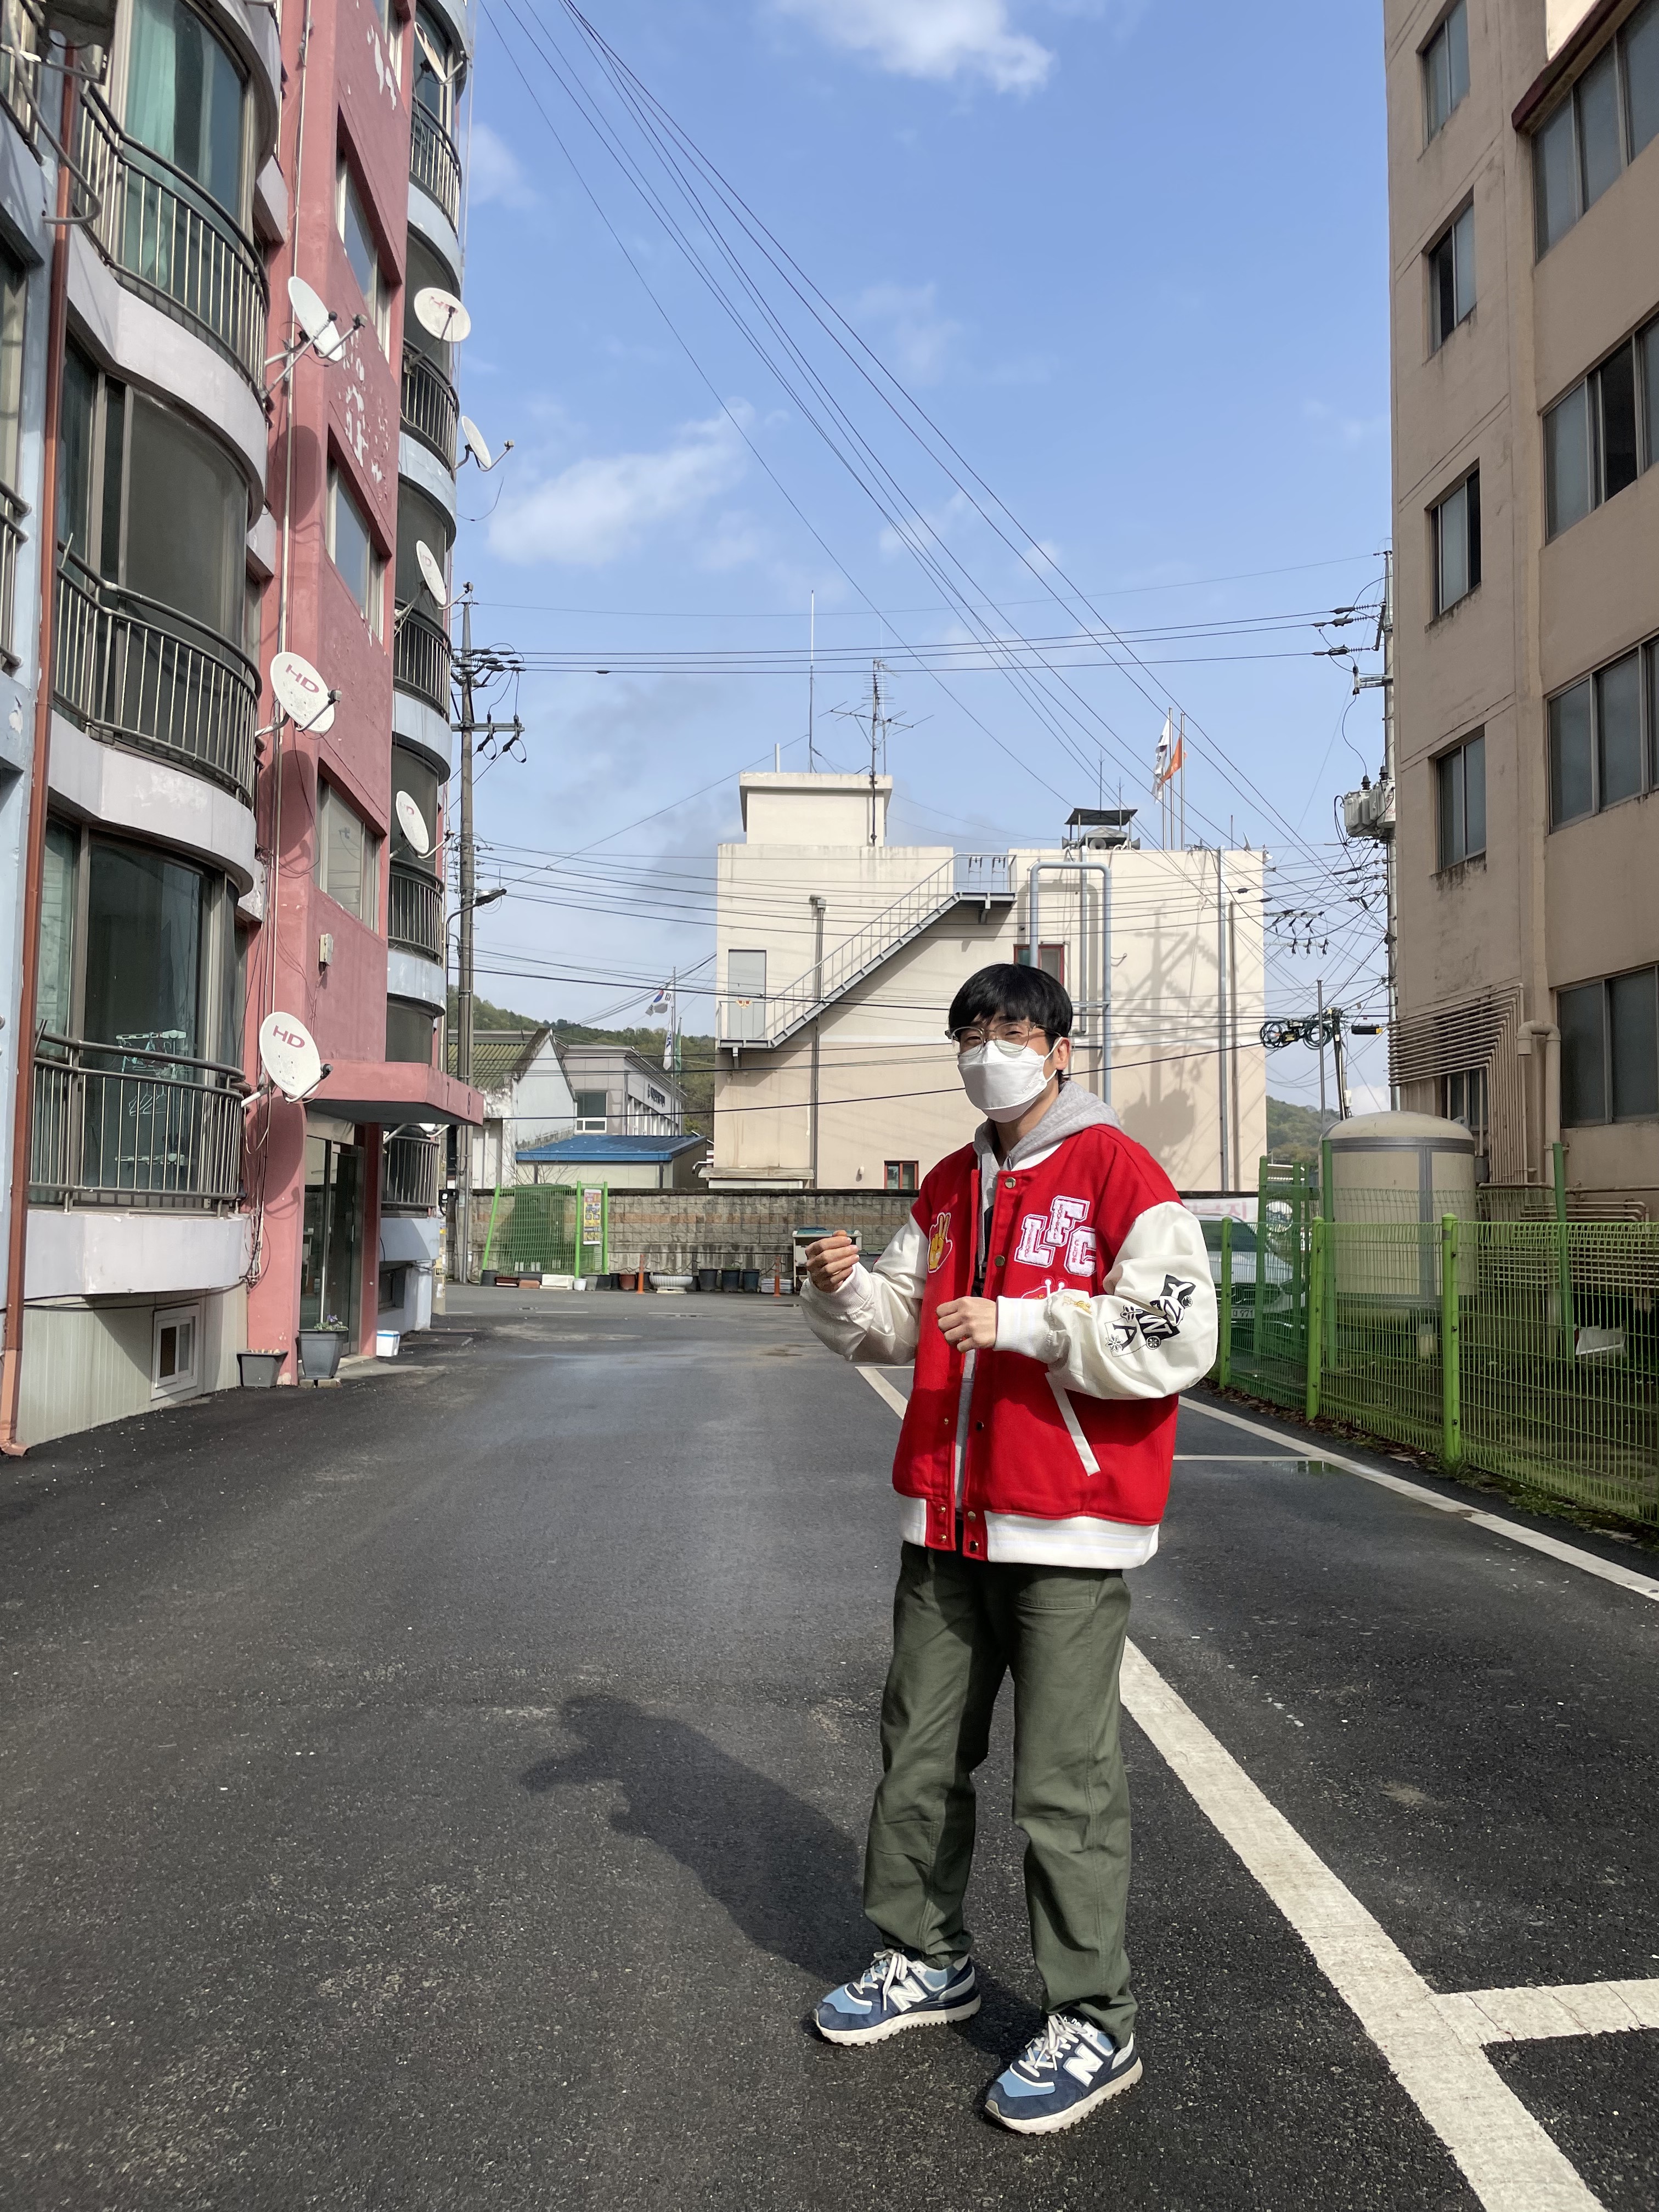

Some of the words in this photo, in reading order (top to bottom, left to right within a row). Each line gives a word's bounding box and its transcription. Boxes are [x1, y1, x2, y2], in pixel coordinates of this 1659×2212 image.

[285, 664, 320, 693] HD
[273, 1025, 305, 1048] HD
[467, 1092, 471, 1115] 8
[888, 1975, 928, 2013] N
[1062, 2042, 1104, 2087] N
